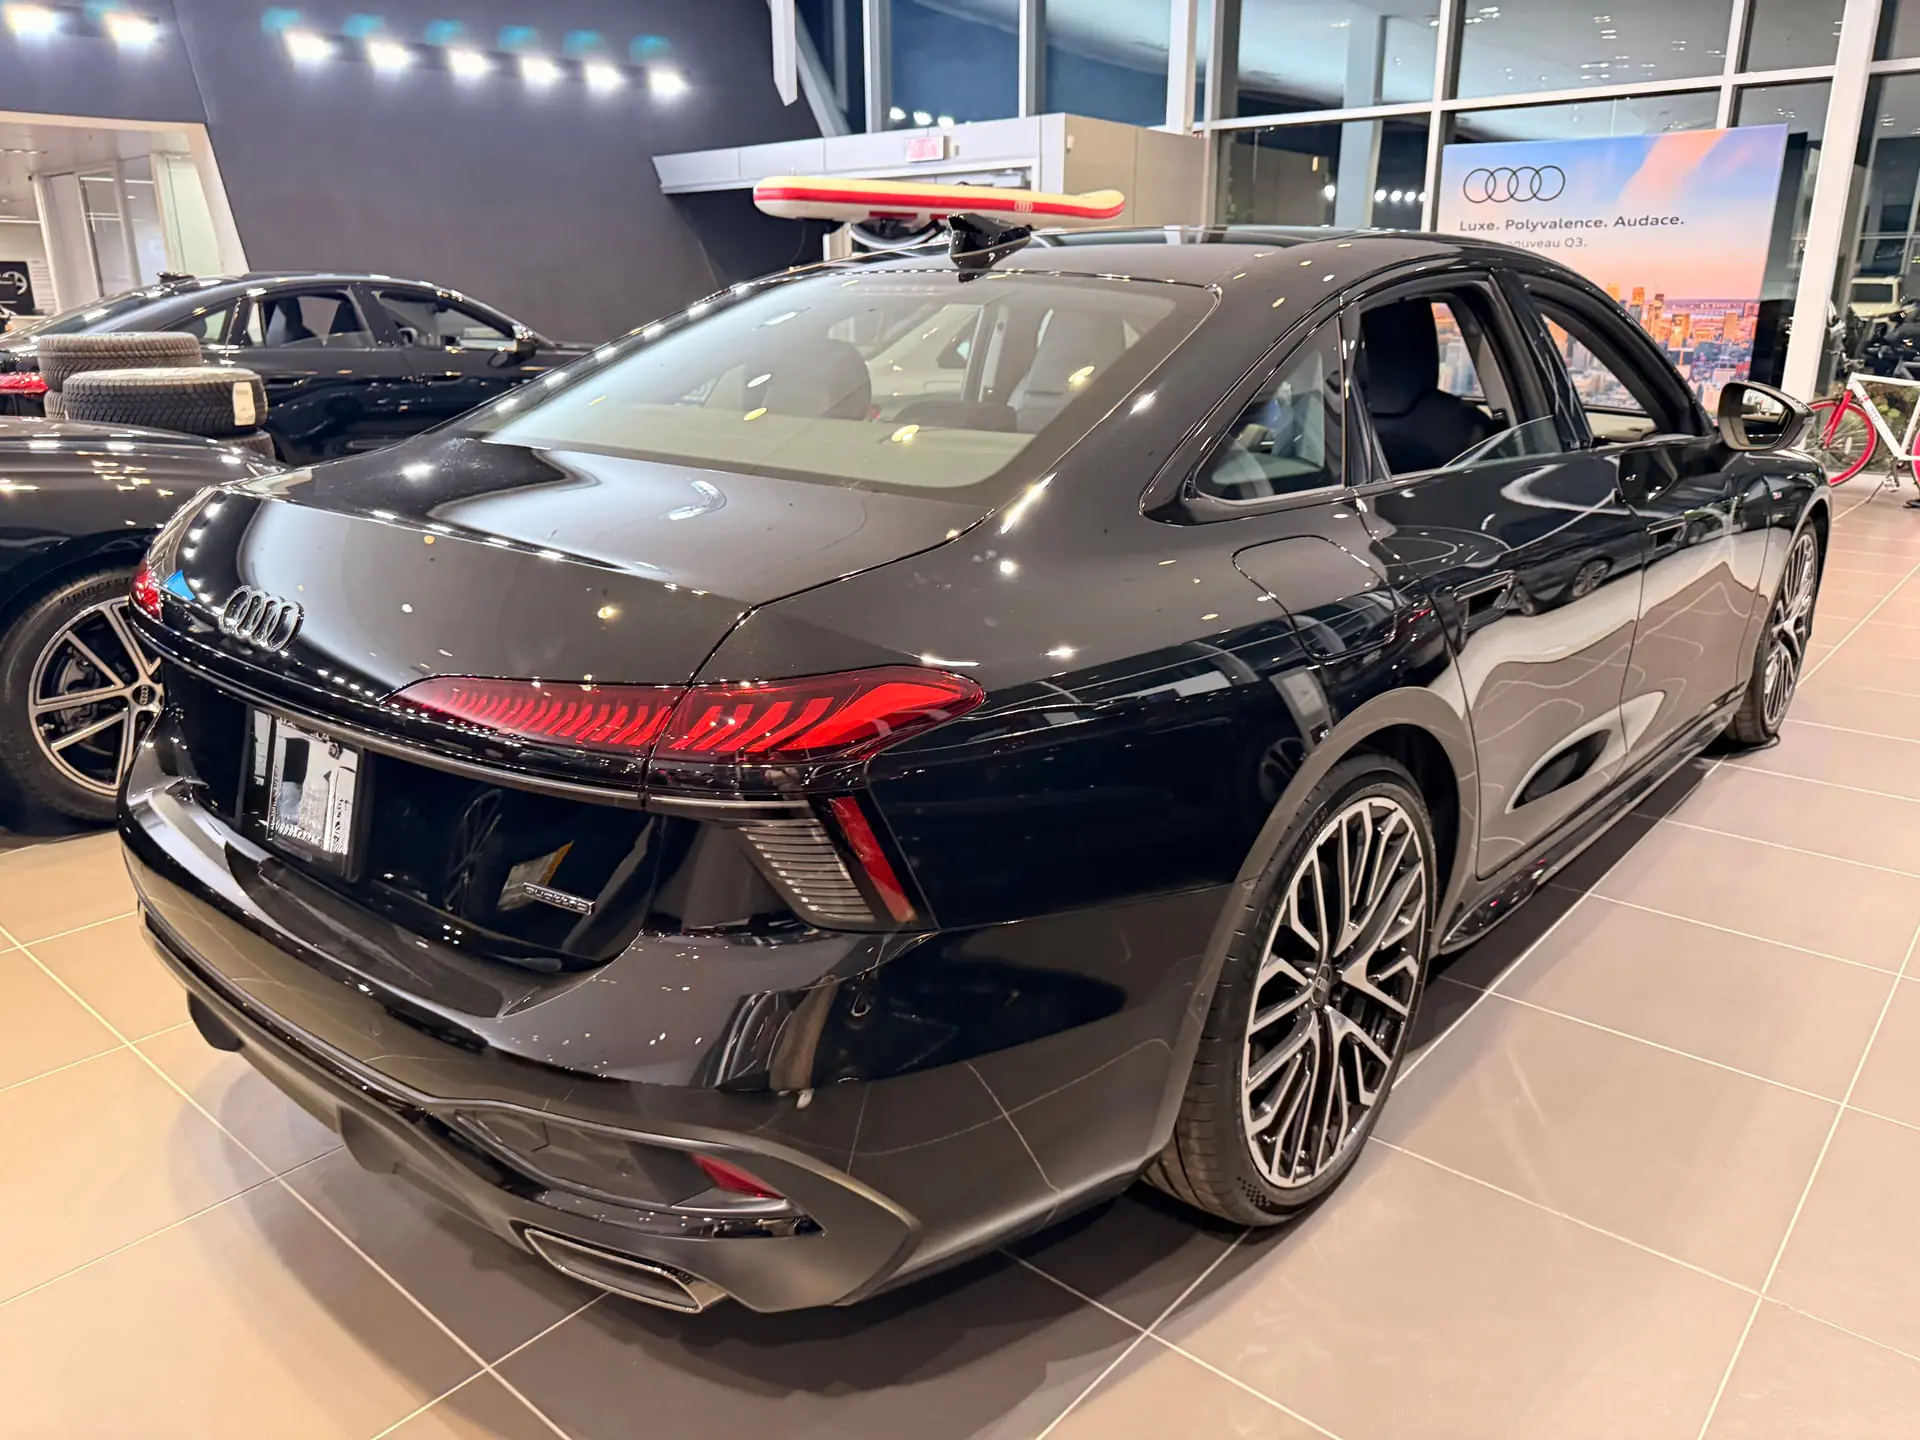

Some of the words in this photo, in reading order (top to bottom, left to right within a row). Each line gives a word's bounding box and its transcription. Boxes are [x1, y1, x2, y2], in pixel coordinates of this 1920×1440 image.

[1459, 220, 1500, 232] Luxe.
[1505, 218, 1608, 232] Polyvalence.
[1613, 214, 1685, 228] Audace.
[1507, 237, 1561, 249] ouveau
[1564, 236, 1588, 249] Q3.
